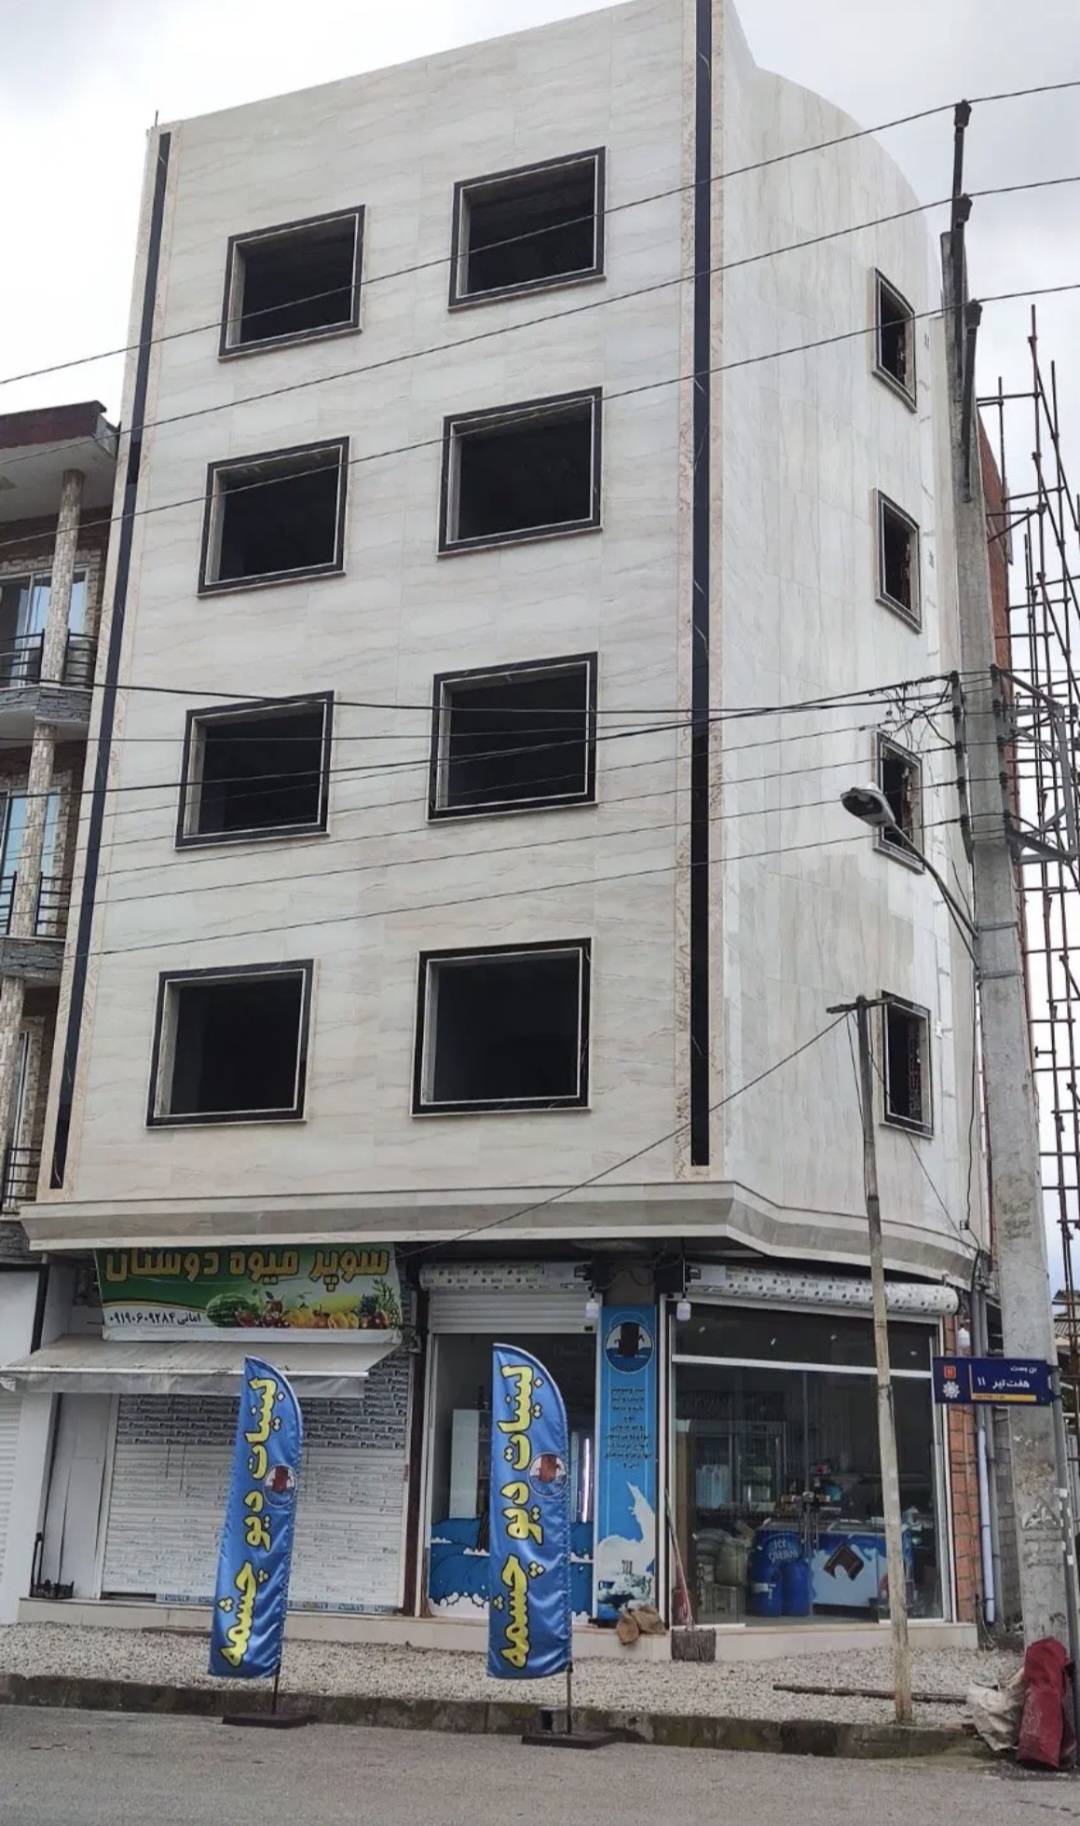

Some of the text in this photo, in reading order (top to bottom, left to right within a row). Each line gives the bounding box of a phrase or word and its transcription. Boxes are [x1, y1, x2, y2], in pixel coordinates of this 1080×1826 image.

[106, 1248, 220, 1283] دوستان
[229, 1250, 299, 1285] میوه
[309, 1249, 390, 1292] سوپر
[977, 1376, 1030, 1390] هفت تیر ۱۱
[245, 1377, 285, 1480] لبنیات
[497, 1364, 544, 1472] لبنیات
